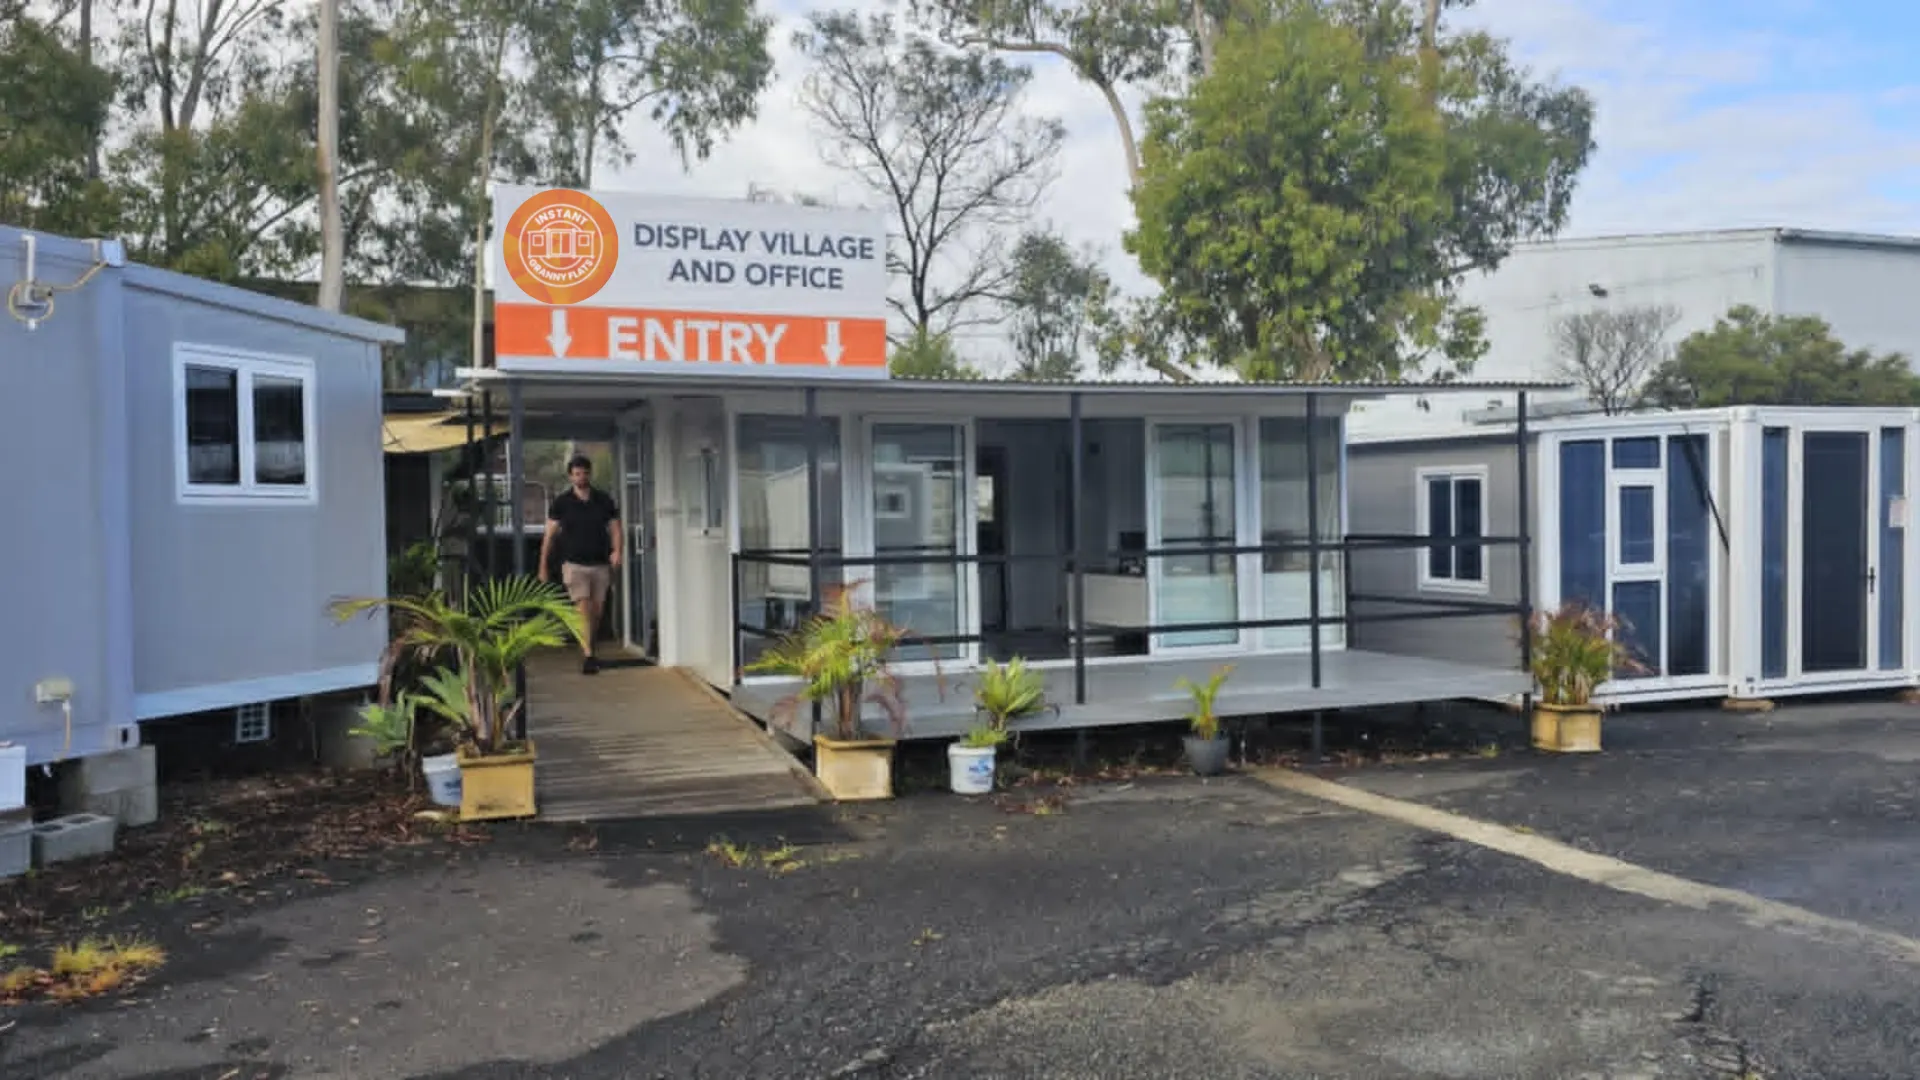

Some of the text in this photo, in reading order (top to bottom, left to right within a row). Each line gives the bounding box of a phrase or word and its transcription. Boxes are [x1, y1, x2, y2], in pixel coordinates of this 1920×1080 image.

[535, 209, 588, 225] INSTANT
[634, 222, 875, 260] DISPLAY VILLAGE
[529, 259, 593, 281] GRANNY FLATS
[668, 259, 844, 290] AND OFFICE
[607, 316, 788, 365] ENTRY
